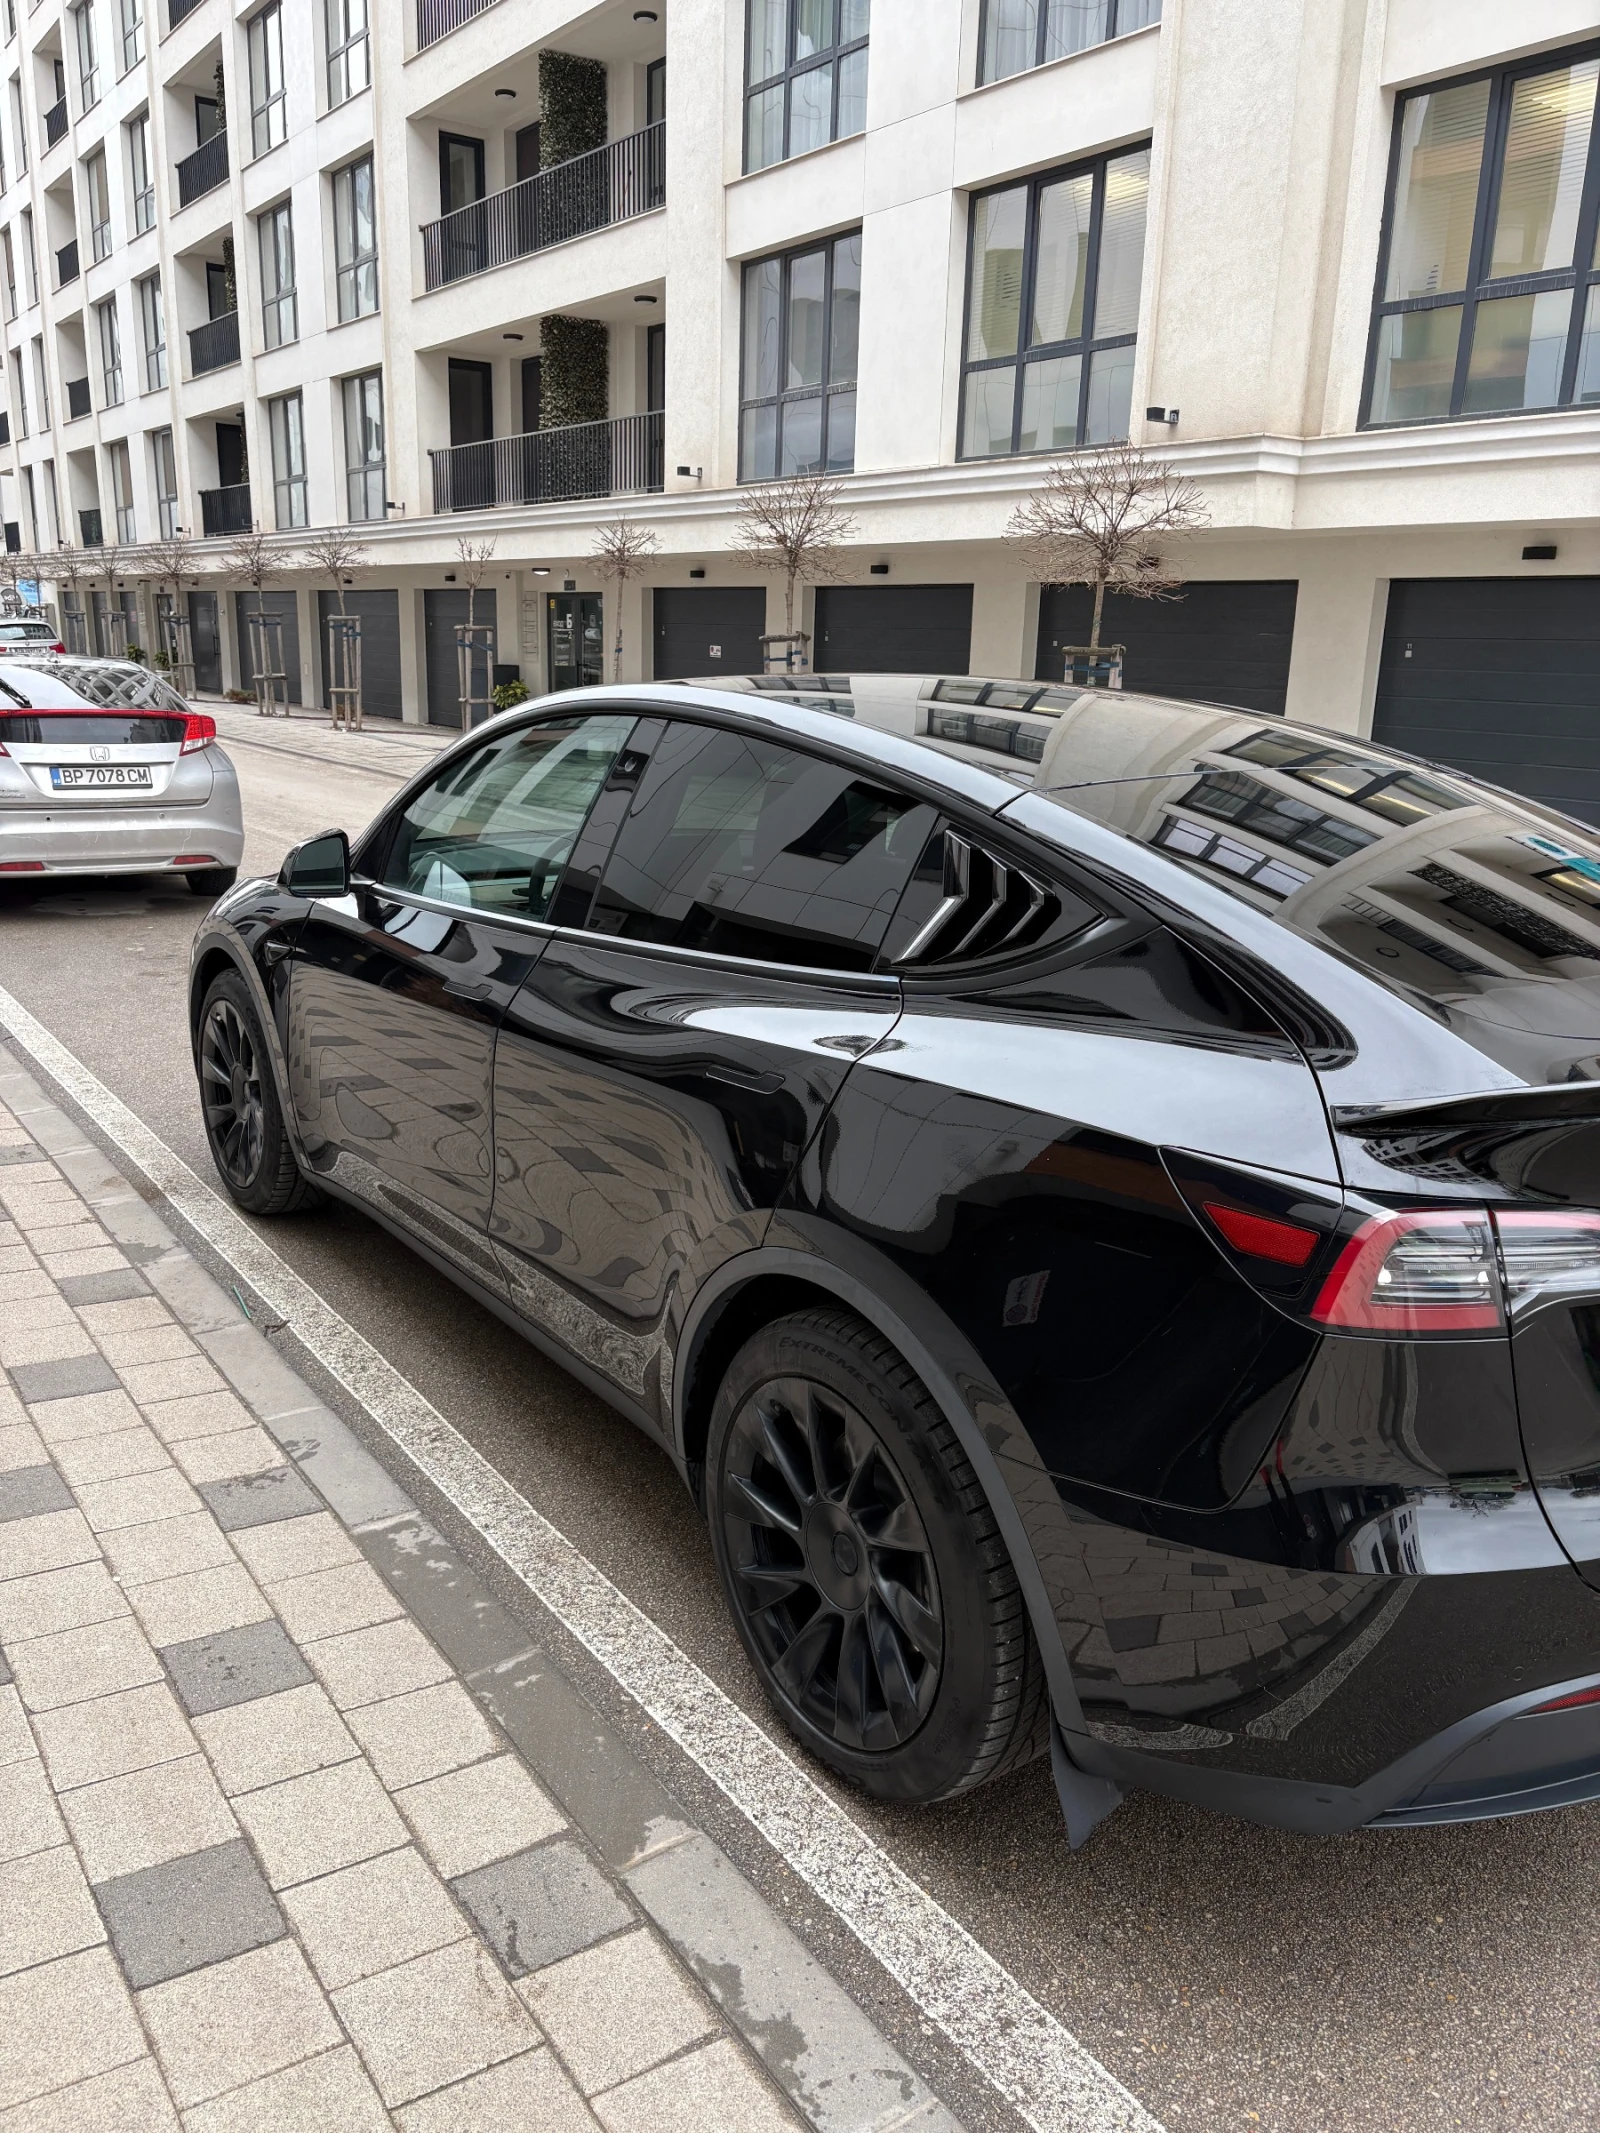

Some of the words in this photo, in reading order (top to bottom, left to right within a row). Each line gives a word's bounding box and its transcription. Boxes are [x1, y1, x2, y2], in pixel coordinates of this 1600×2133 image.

[62, 769, 83, 784] BP
[86, 769, 125, 784] 7078
[127, 768, 149, 783] CM
